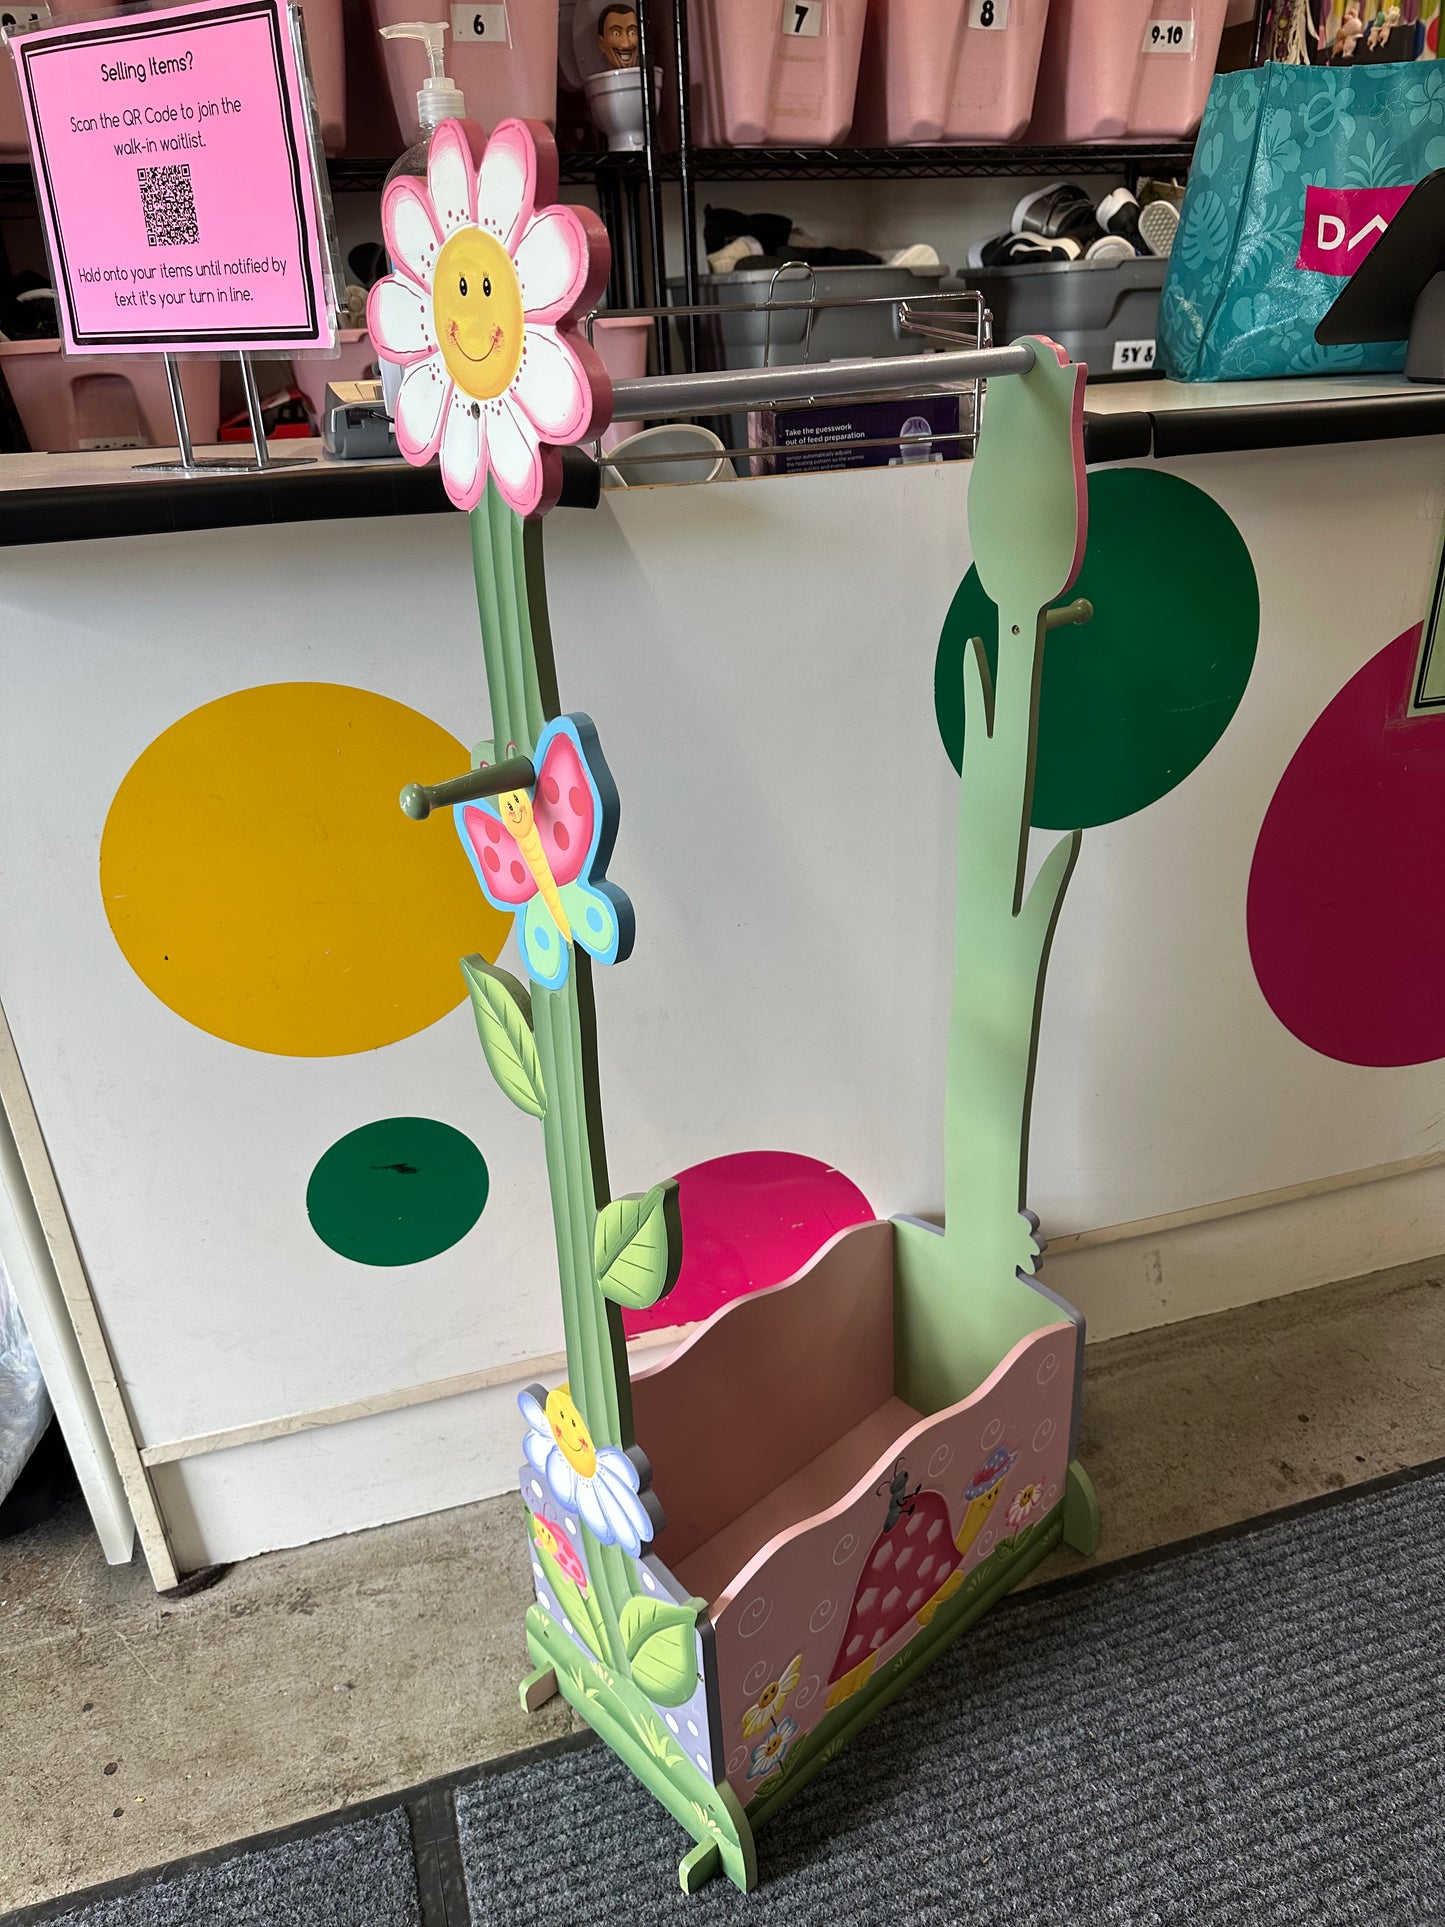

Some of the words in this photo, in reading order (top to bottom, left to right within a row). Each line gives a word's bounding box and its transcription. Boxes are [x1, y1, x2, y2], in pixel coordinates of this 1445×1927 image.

[474, 14, 485, 35] 6
[795, 5, 809, 33] 7
[981, 0, 994, 27] 8
[1152, 26, 1182, 44] 9-10
[101, 61, 146, 82] Selling
[149, 51, 193, 76] Items?
[70, 117, 97, 132] Scan
[100, 113, 120, 129] the
[123, 109, 142, 126] QR
[145, 105, 177, 123] Code
[181, 103, 193, 119] to
[198, 101, 219, 122] join
[222, 97, 241, 113] the
[114, 138, 157, 156] walk-in
[160, 131, 206, 151] waitlist.
[78, 267, 100, 282] Hold
[104, 271, 128, 281] onto
[131, 267, 156, 283] your
[160, 263, 193, 278] items
[196, 260, 221, 276] until
[224, 257, 268, 275] notified
[272, 257, 286, 276] by
[115, 292, 137, 307] text
[139, 290, 156, 305] it's
[159, 293, 186, 308] your
[189, 289, 214, 303] turn
[217, 288, 227, 302] in
[230, 287, 253, 301] line.
[1122, 347, 1140, 363] 5Y
[816, 423, 852, 434] guesswork
[825, 432, 865, 443] preparation
